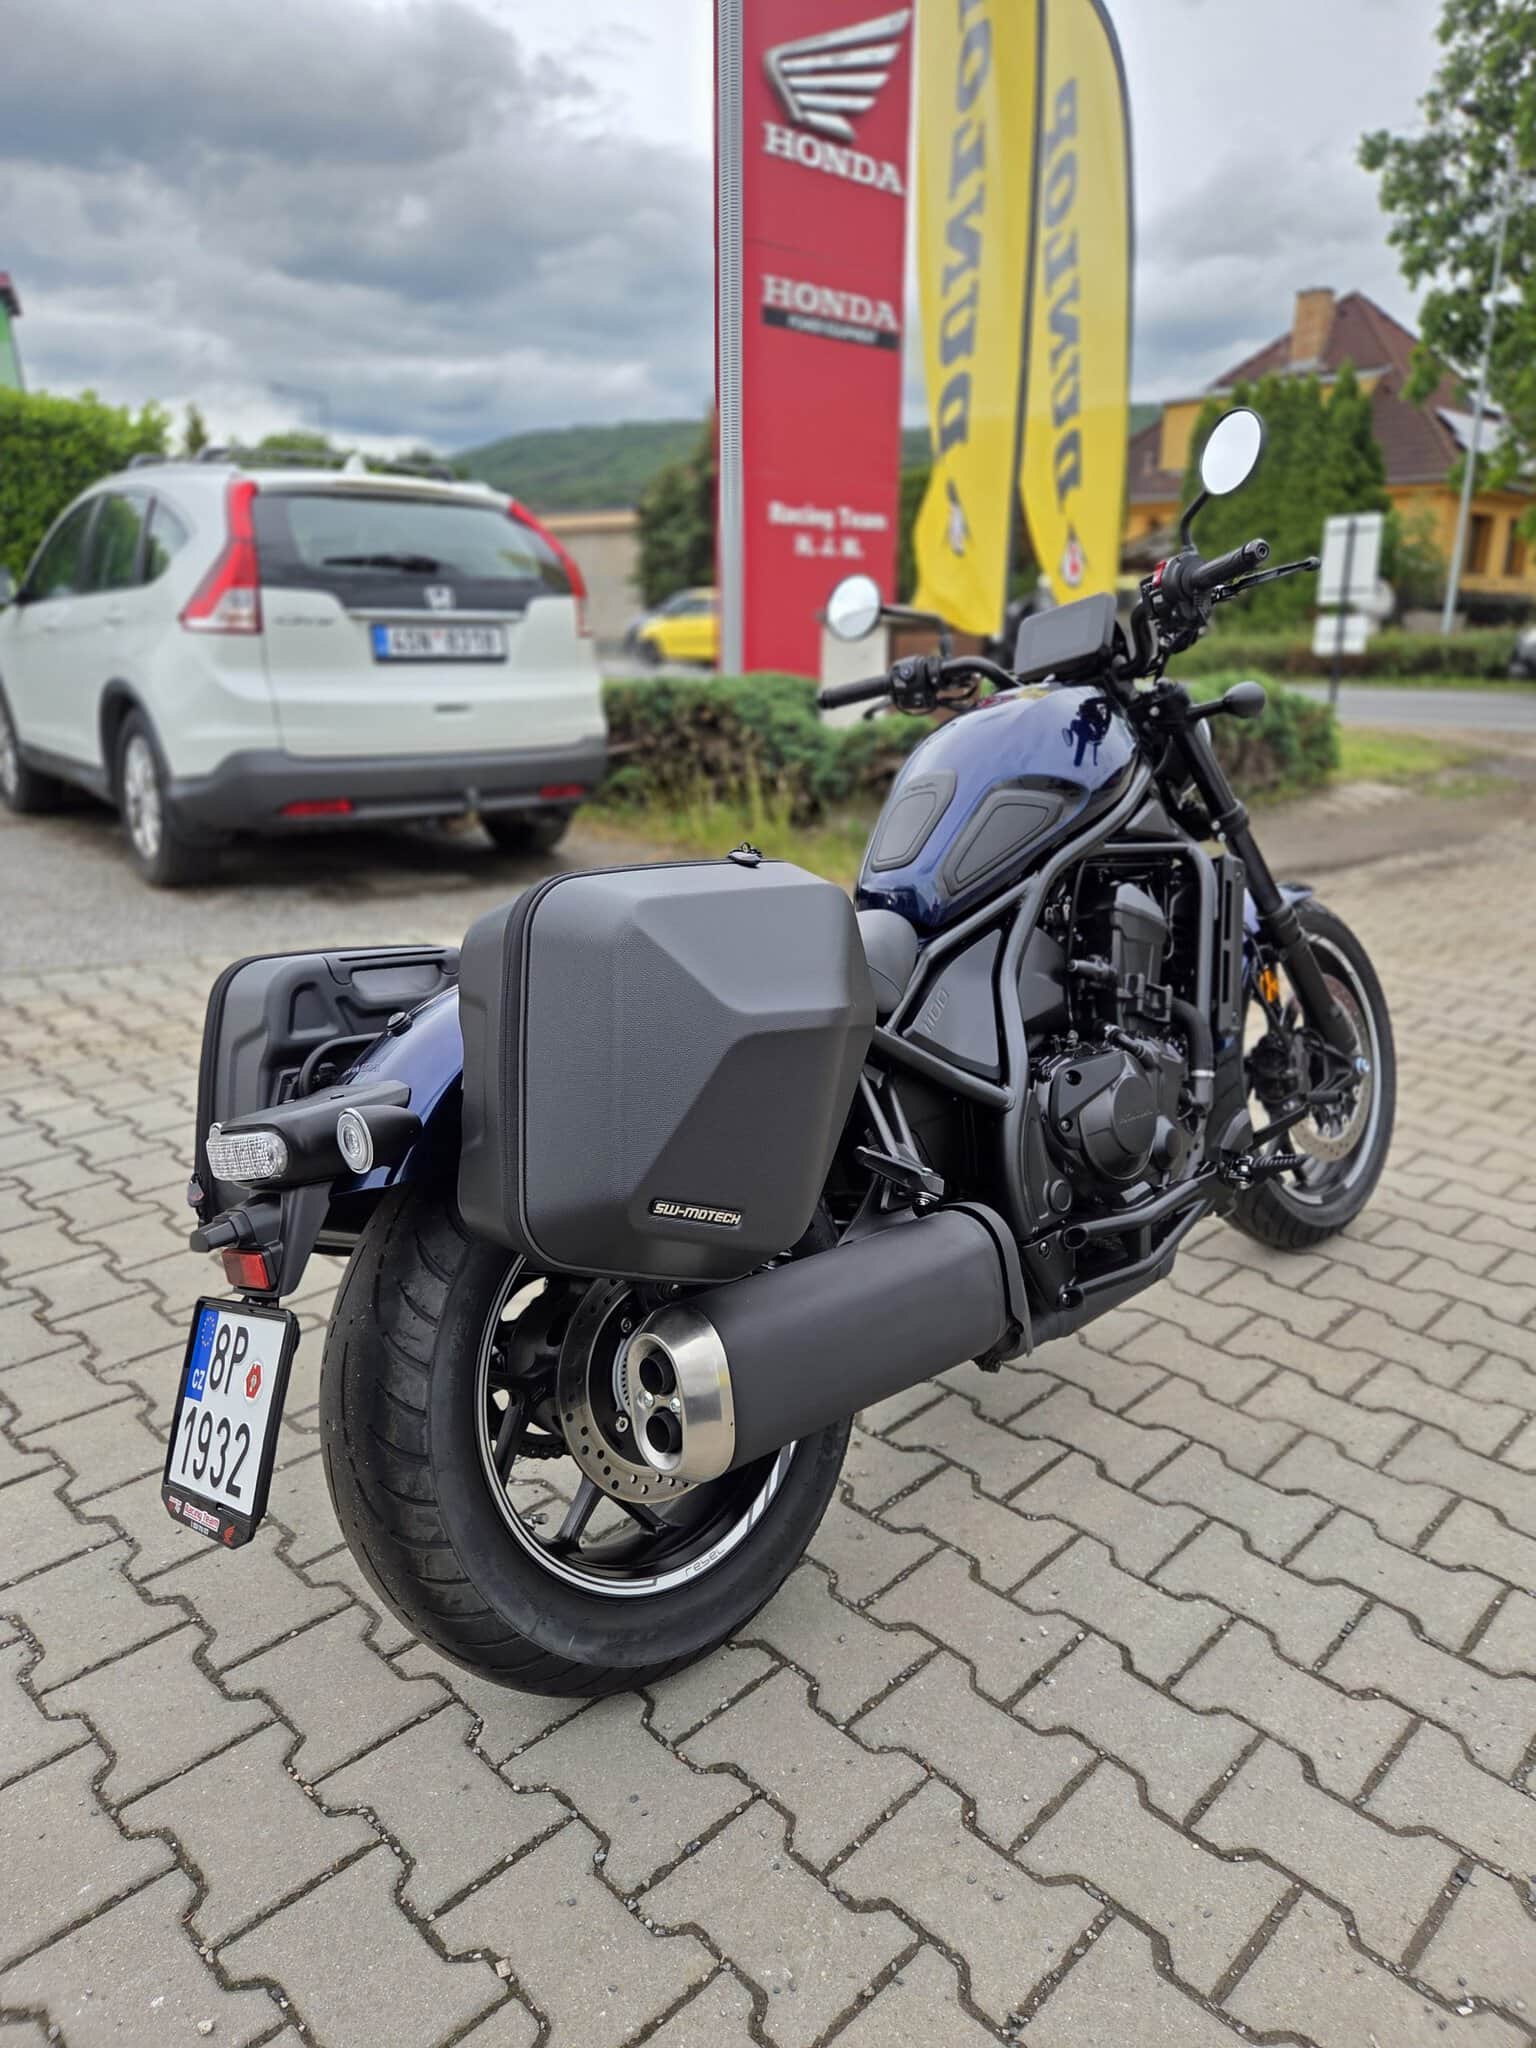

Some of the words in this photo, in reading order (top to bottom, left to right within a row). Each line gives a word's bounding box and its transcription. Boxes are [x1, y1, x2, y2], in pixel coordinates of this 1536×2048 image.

[762, 121, 906, 198] HONDA
[761, 274, 899, 332] HONDA
[768, 500, 835, 532] Racing
[838, 505, 888, 532] Team
[653, 1203, 742, 1226] SW-MOTECH
[191, 1368, 206, 1390] CZ
[209, 1323, 250, 1395] 8P
[181, 1406, 252, 1498] 1932
